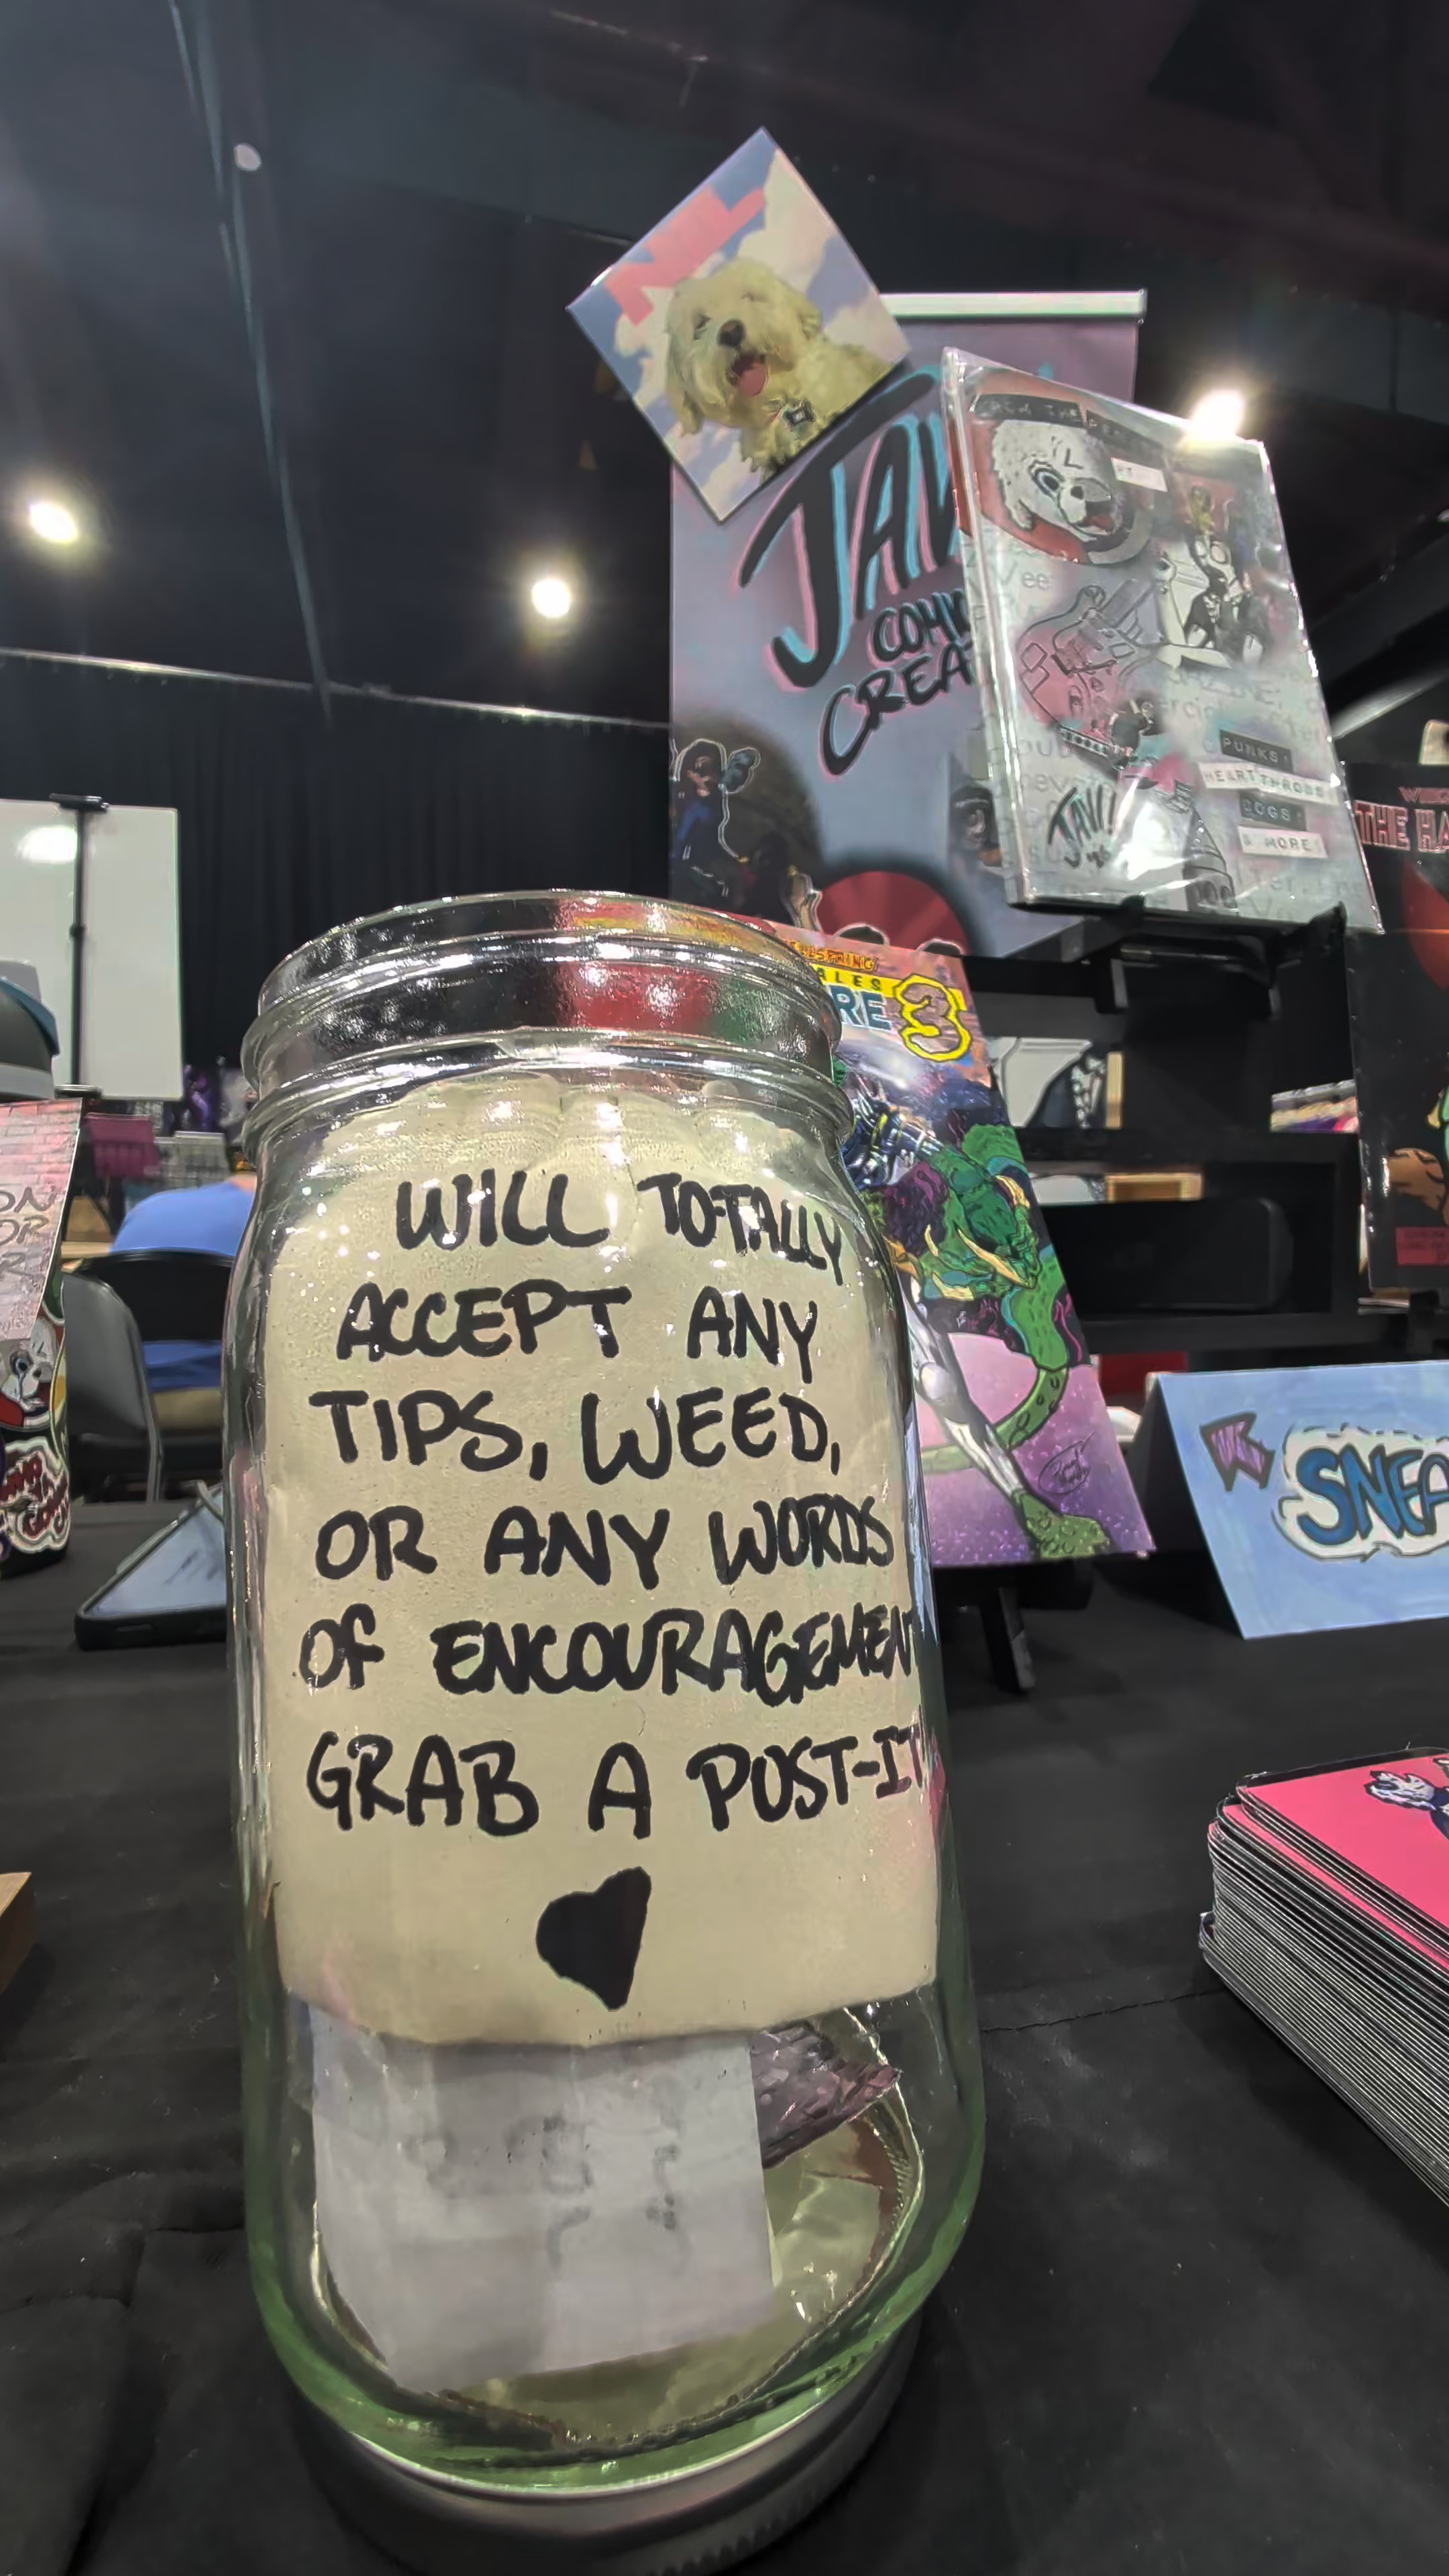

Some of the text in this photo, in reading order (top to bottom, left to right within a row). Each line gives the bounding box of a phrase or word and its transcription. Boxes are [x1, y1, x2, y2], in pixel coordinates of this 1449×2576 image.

[820, 641, 973, 777] CREA
[1352, 800, 1410, 851] THE
[893, 973, 971, 1063] 3
[396, 1169, 843, 1285] WILL TOTALLY
[337, 1279, 818, 1384] ACCEPT ANY
[309, 1386, 841, 1486] TIPS, WEED,
[315, 1493, 895, 1591] OR ANY WORDS
[306, 1731, 539, 1837] GRAB
[587, 1741, 652, 1840] A
